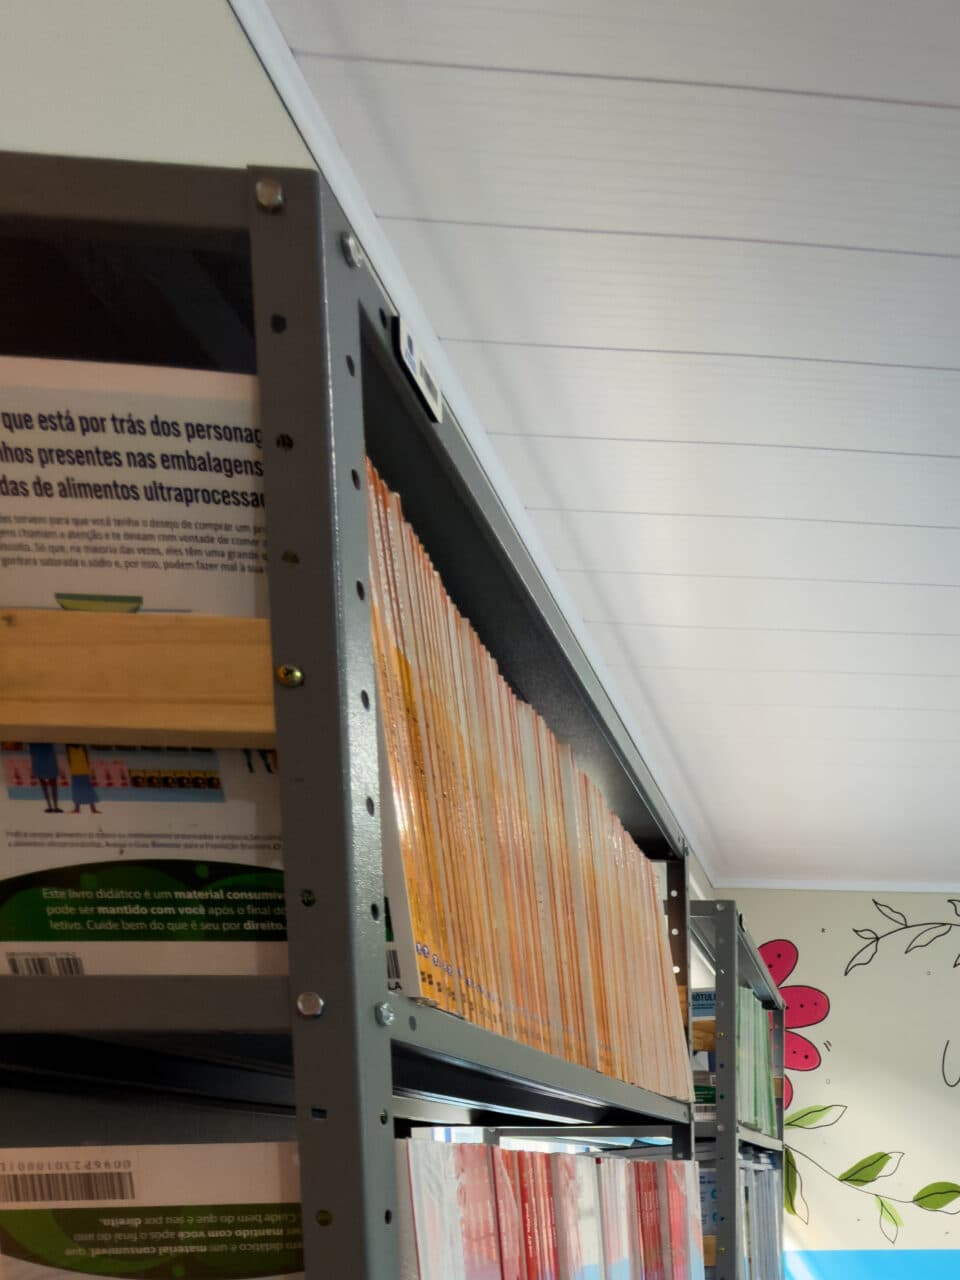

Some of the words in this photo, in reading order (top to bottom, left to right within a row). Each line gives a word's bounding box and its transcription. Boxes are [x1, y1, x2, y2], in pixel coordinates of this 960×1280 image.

[1, 412, 33, 433] que
[39, 410, 75, 432] está
[80, 416, 106, 436] por
[112, 413, 147, 436] trás
[151, 415, 181, 438] dos
[38, 450, 122, 468] presentes
[127, 453, 156, 470] nas
[161, 451, 264, 478] embalagens
[34, 476, 54, 498] de
[59, 477, 140, 501] alimentos
[96, 888, 141, 899] didático
[153, 891, 172, 899] um
[174, 888, 223, 900] material
[47, 905, 75, 917] pode
[98, 904, 148, 915] mantido
[151, 906, 175, 915] com
[178, 904, 205, 915] você
[87, 920, 120, 930] Cuide
[123, 920, 147, 930] bem
[150, 920, 164, 930] do
[167, 922, 189, 933] que
[222, 922, 240, 933] por
[208, 1229, 232, 1239] com
[235, 1228, 283, 1239] mantido
[158, 1245, 207, 1256] material
